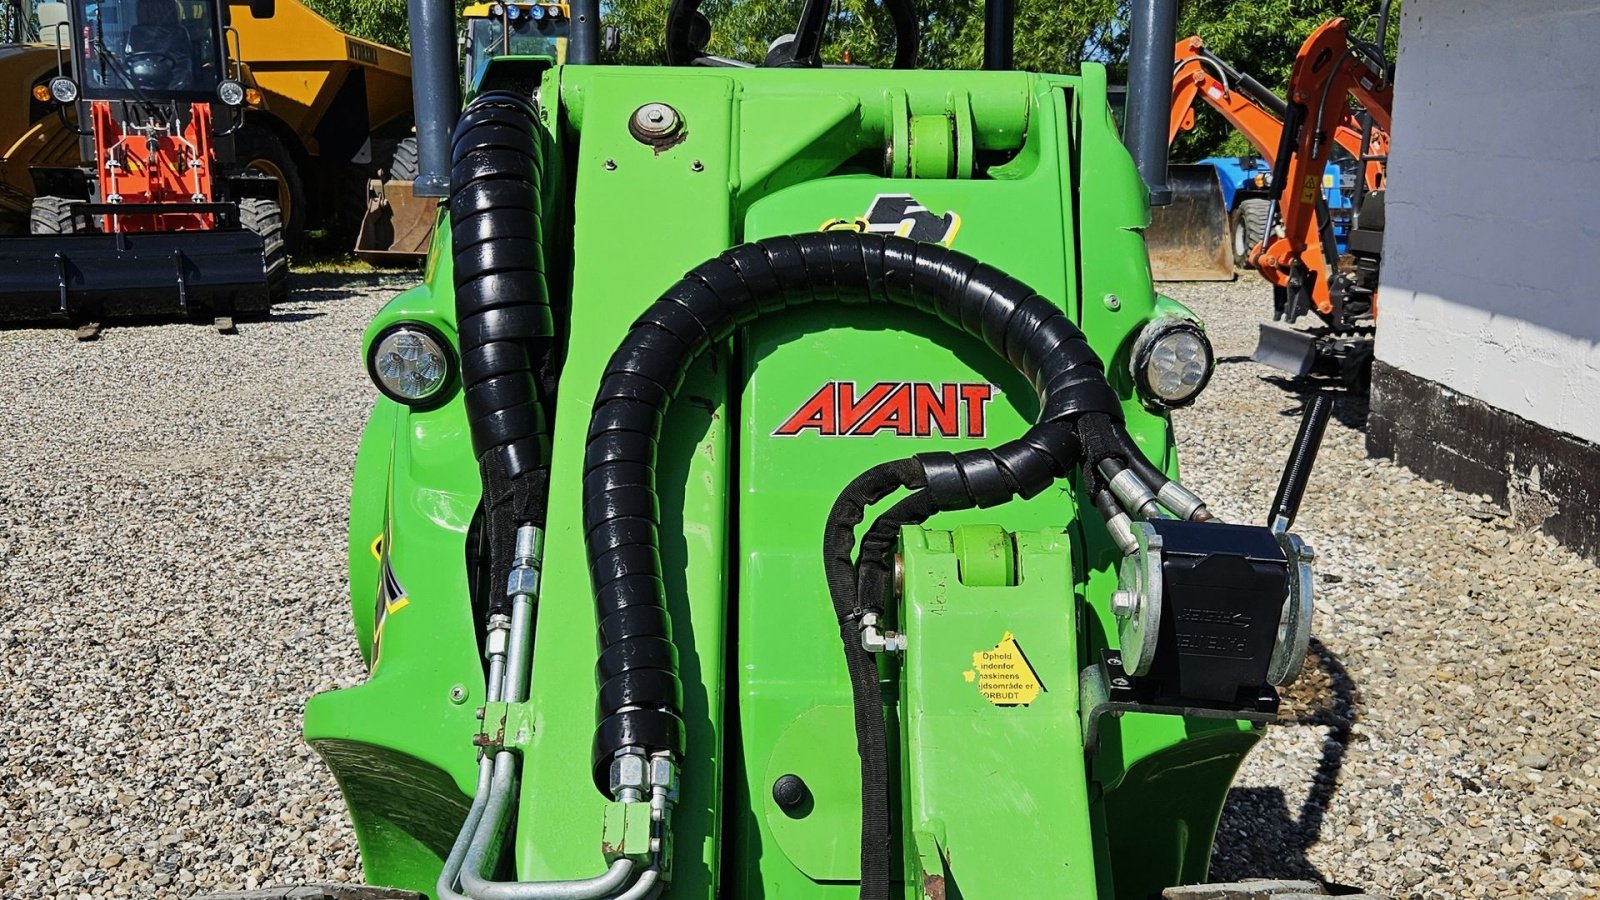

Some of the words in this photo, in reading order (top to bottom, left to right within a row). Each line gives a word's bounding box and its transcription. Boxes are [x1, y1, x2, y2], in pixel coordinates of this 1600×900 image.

[772, 381, 992, 438] AVANT
[982, 652, 1012, 661] Ophold
[981, 662, 1015, 670] indenfor
[978, 682, 1023, 690] jdsområde
